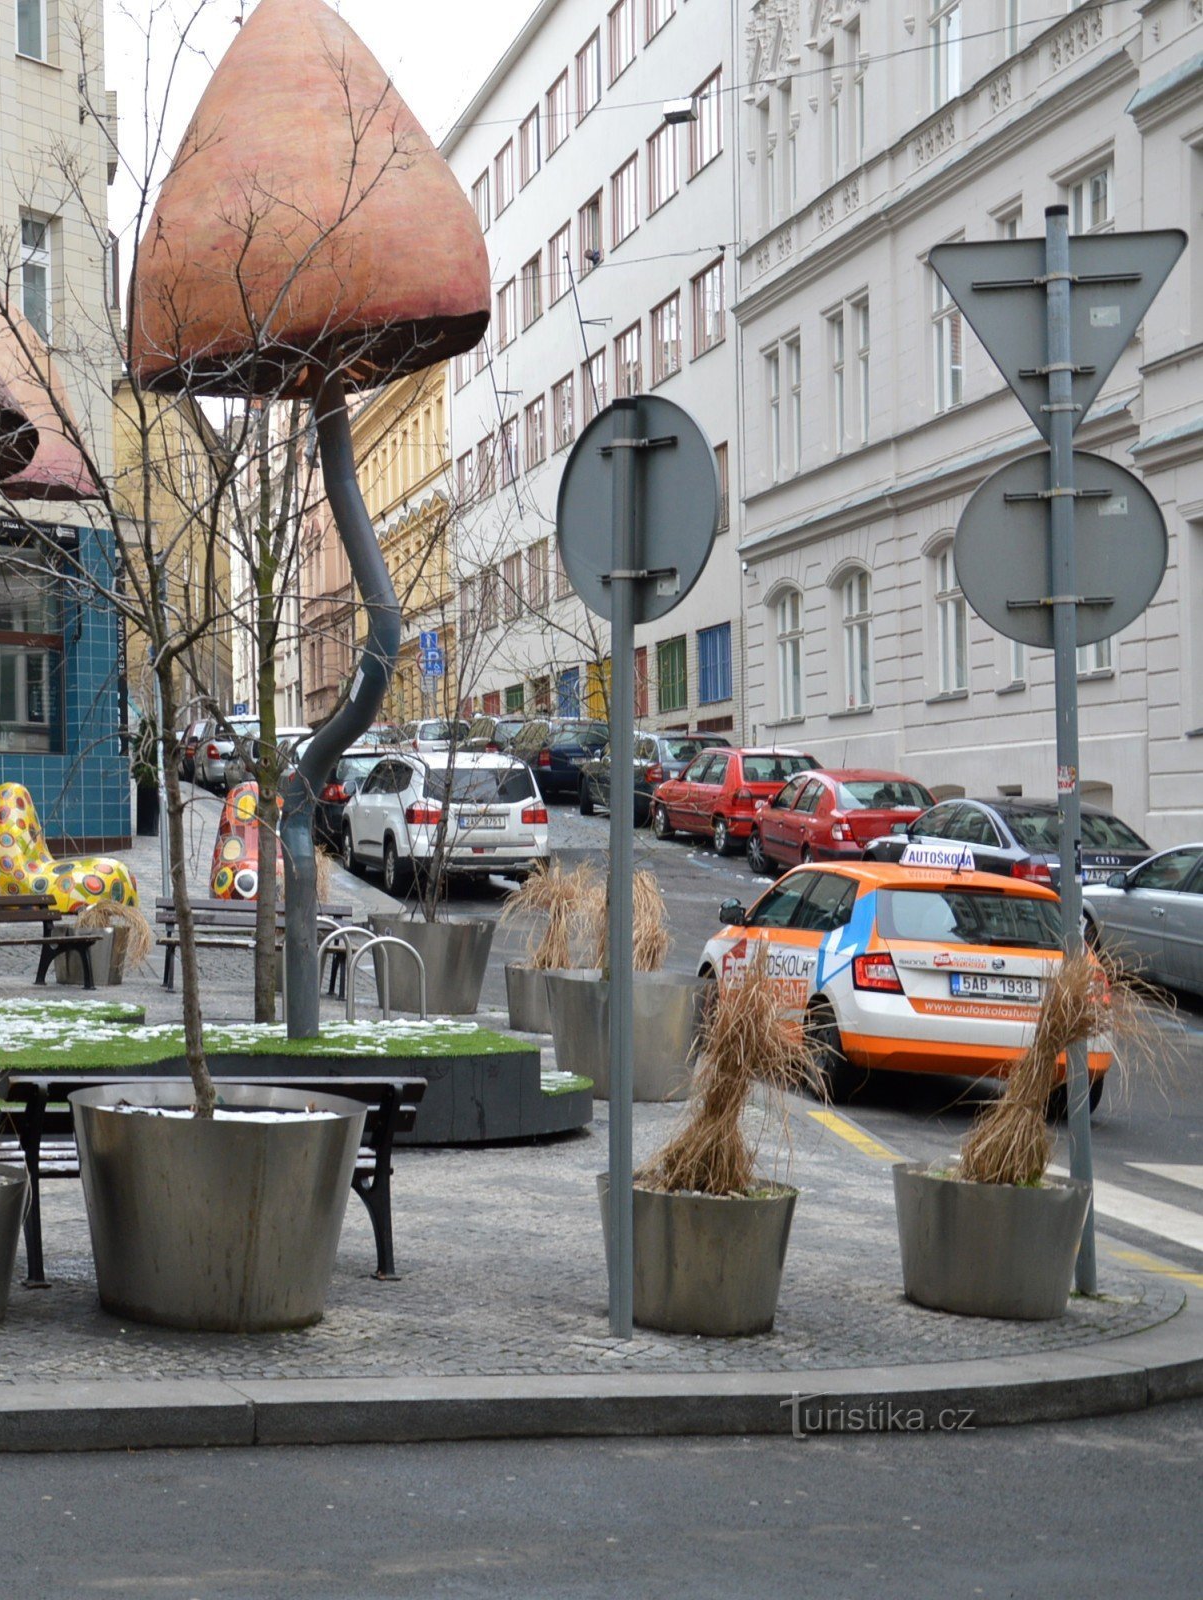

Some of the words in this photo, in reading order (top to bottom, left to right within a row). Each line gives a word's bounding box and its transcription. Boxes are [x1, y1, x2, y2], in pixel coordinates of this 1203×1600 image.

[117, 614, 126, 676] RESTAURA
[428, 651, 439, 668] P
[236, 706, 245, 715] P
[908, 850, 972, 866] AUTOŠKOLA
[750, 951, 809, 977] OŠKOLA
[963, 975, 988, 991] 5AB
[1000, 979, 1033, 994] 1938
[771, 981, 807, 1008] DENT
